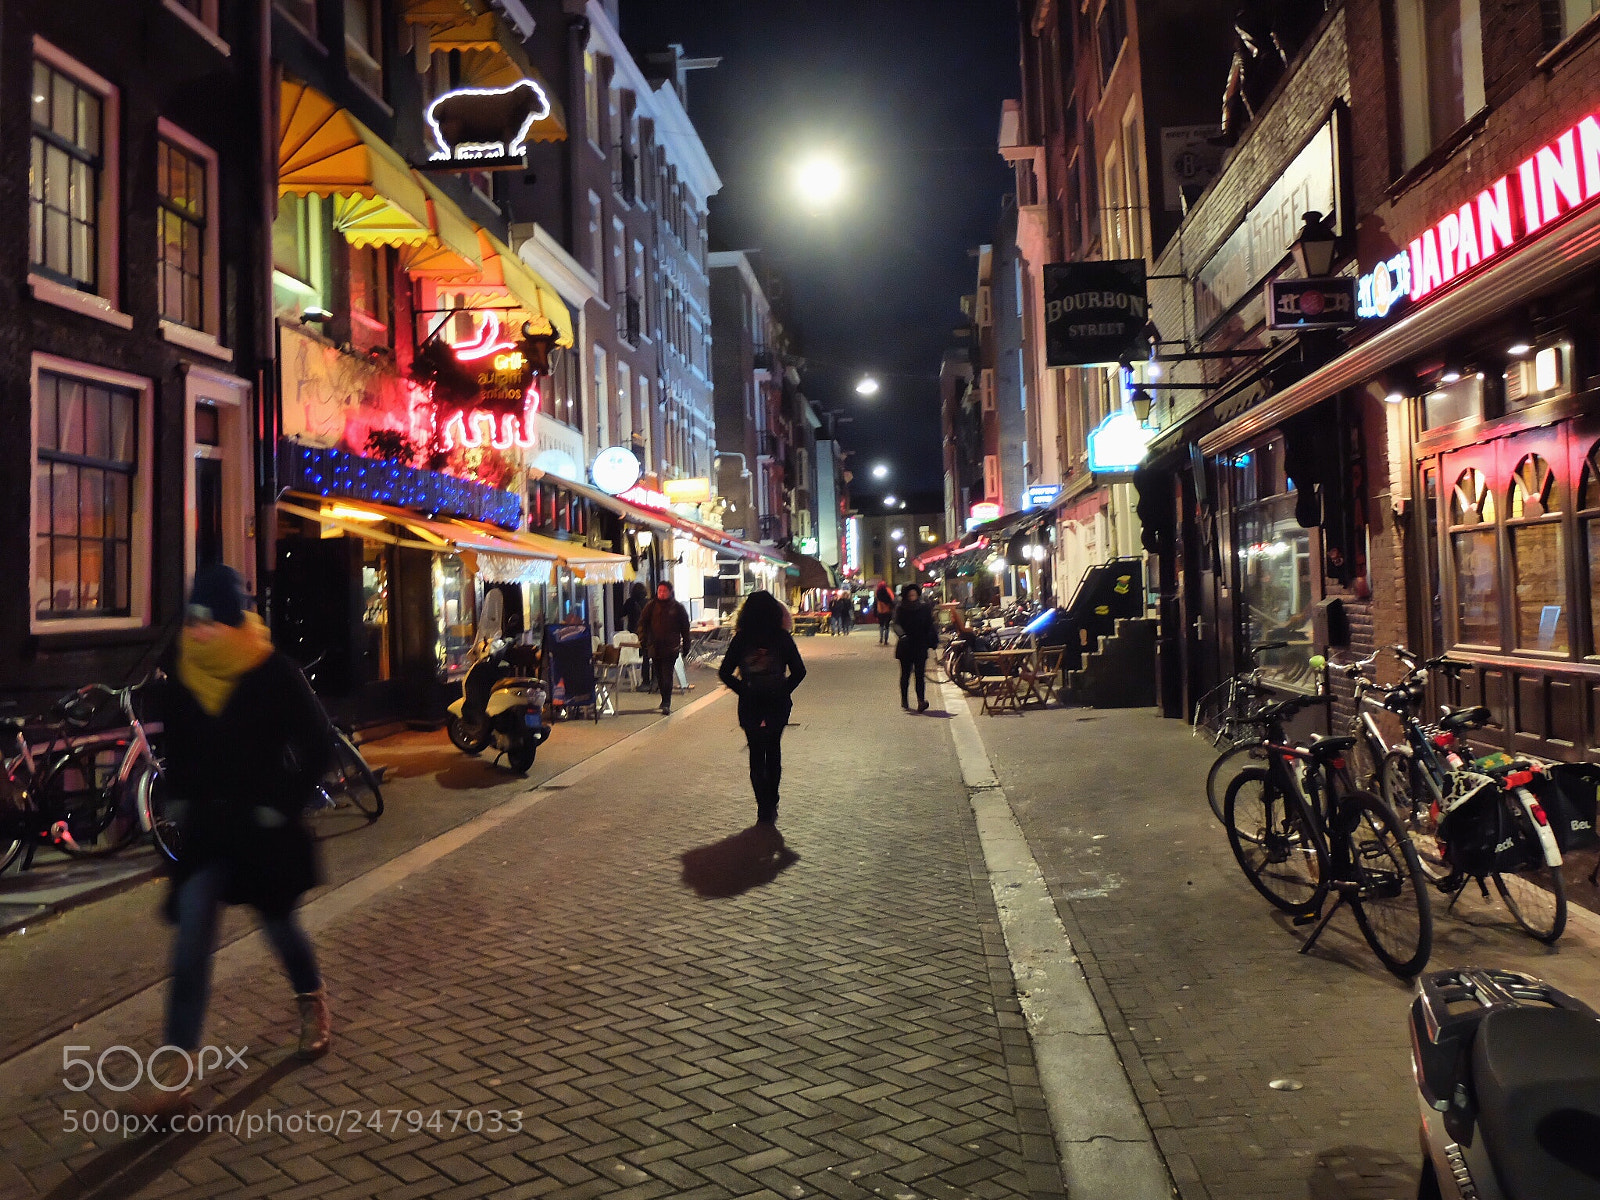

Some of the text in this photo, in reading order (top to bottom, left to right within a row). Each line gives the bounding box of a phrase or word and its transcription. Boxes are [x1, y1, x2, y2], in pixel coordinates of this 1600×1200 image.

[1408, 175, 1515, 301] JAPAN
[1046, 291, 1146, 323] BOURBON
[1068, 322, 1126, 337] STREET
[1495, 837, 1514, 853] eck
